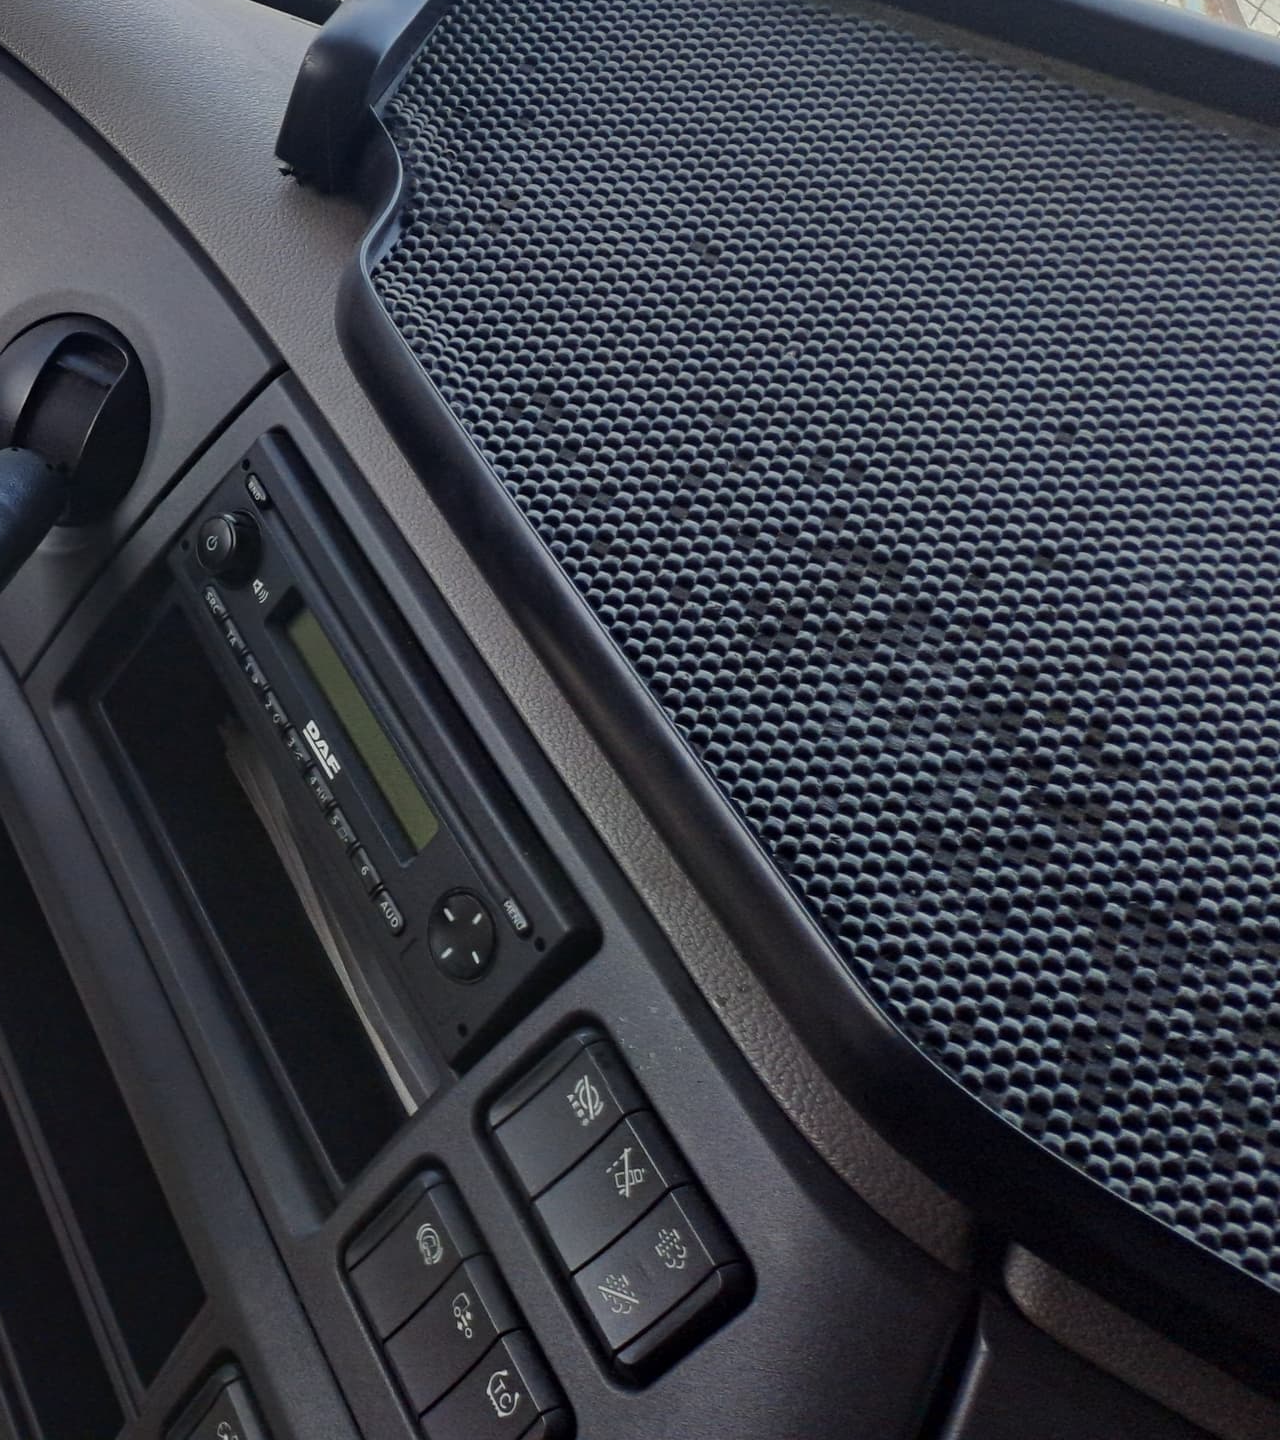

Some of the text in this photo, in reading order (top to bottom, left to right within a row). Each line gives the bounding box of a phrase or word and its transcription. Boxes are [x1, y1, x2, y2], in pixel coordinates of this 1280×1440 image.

[206, 591, 220, 614] SRC
[305, 719, 341, 774] DAF
[360, 865, 369, 876] 6
[493, 1377, 512, 1409] TC
